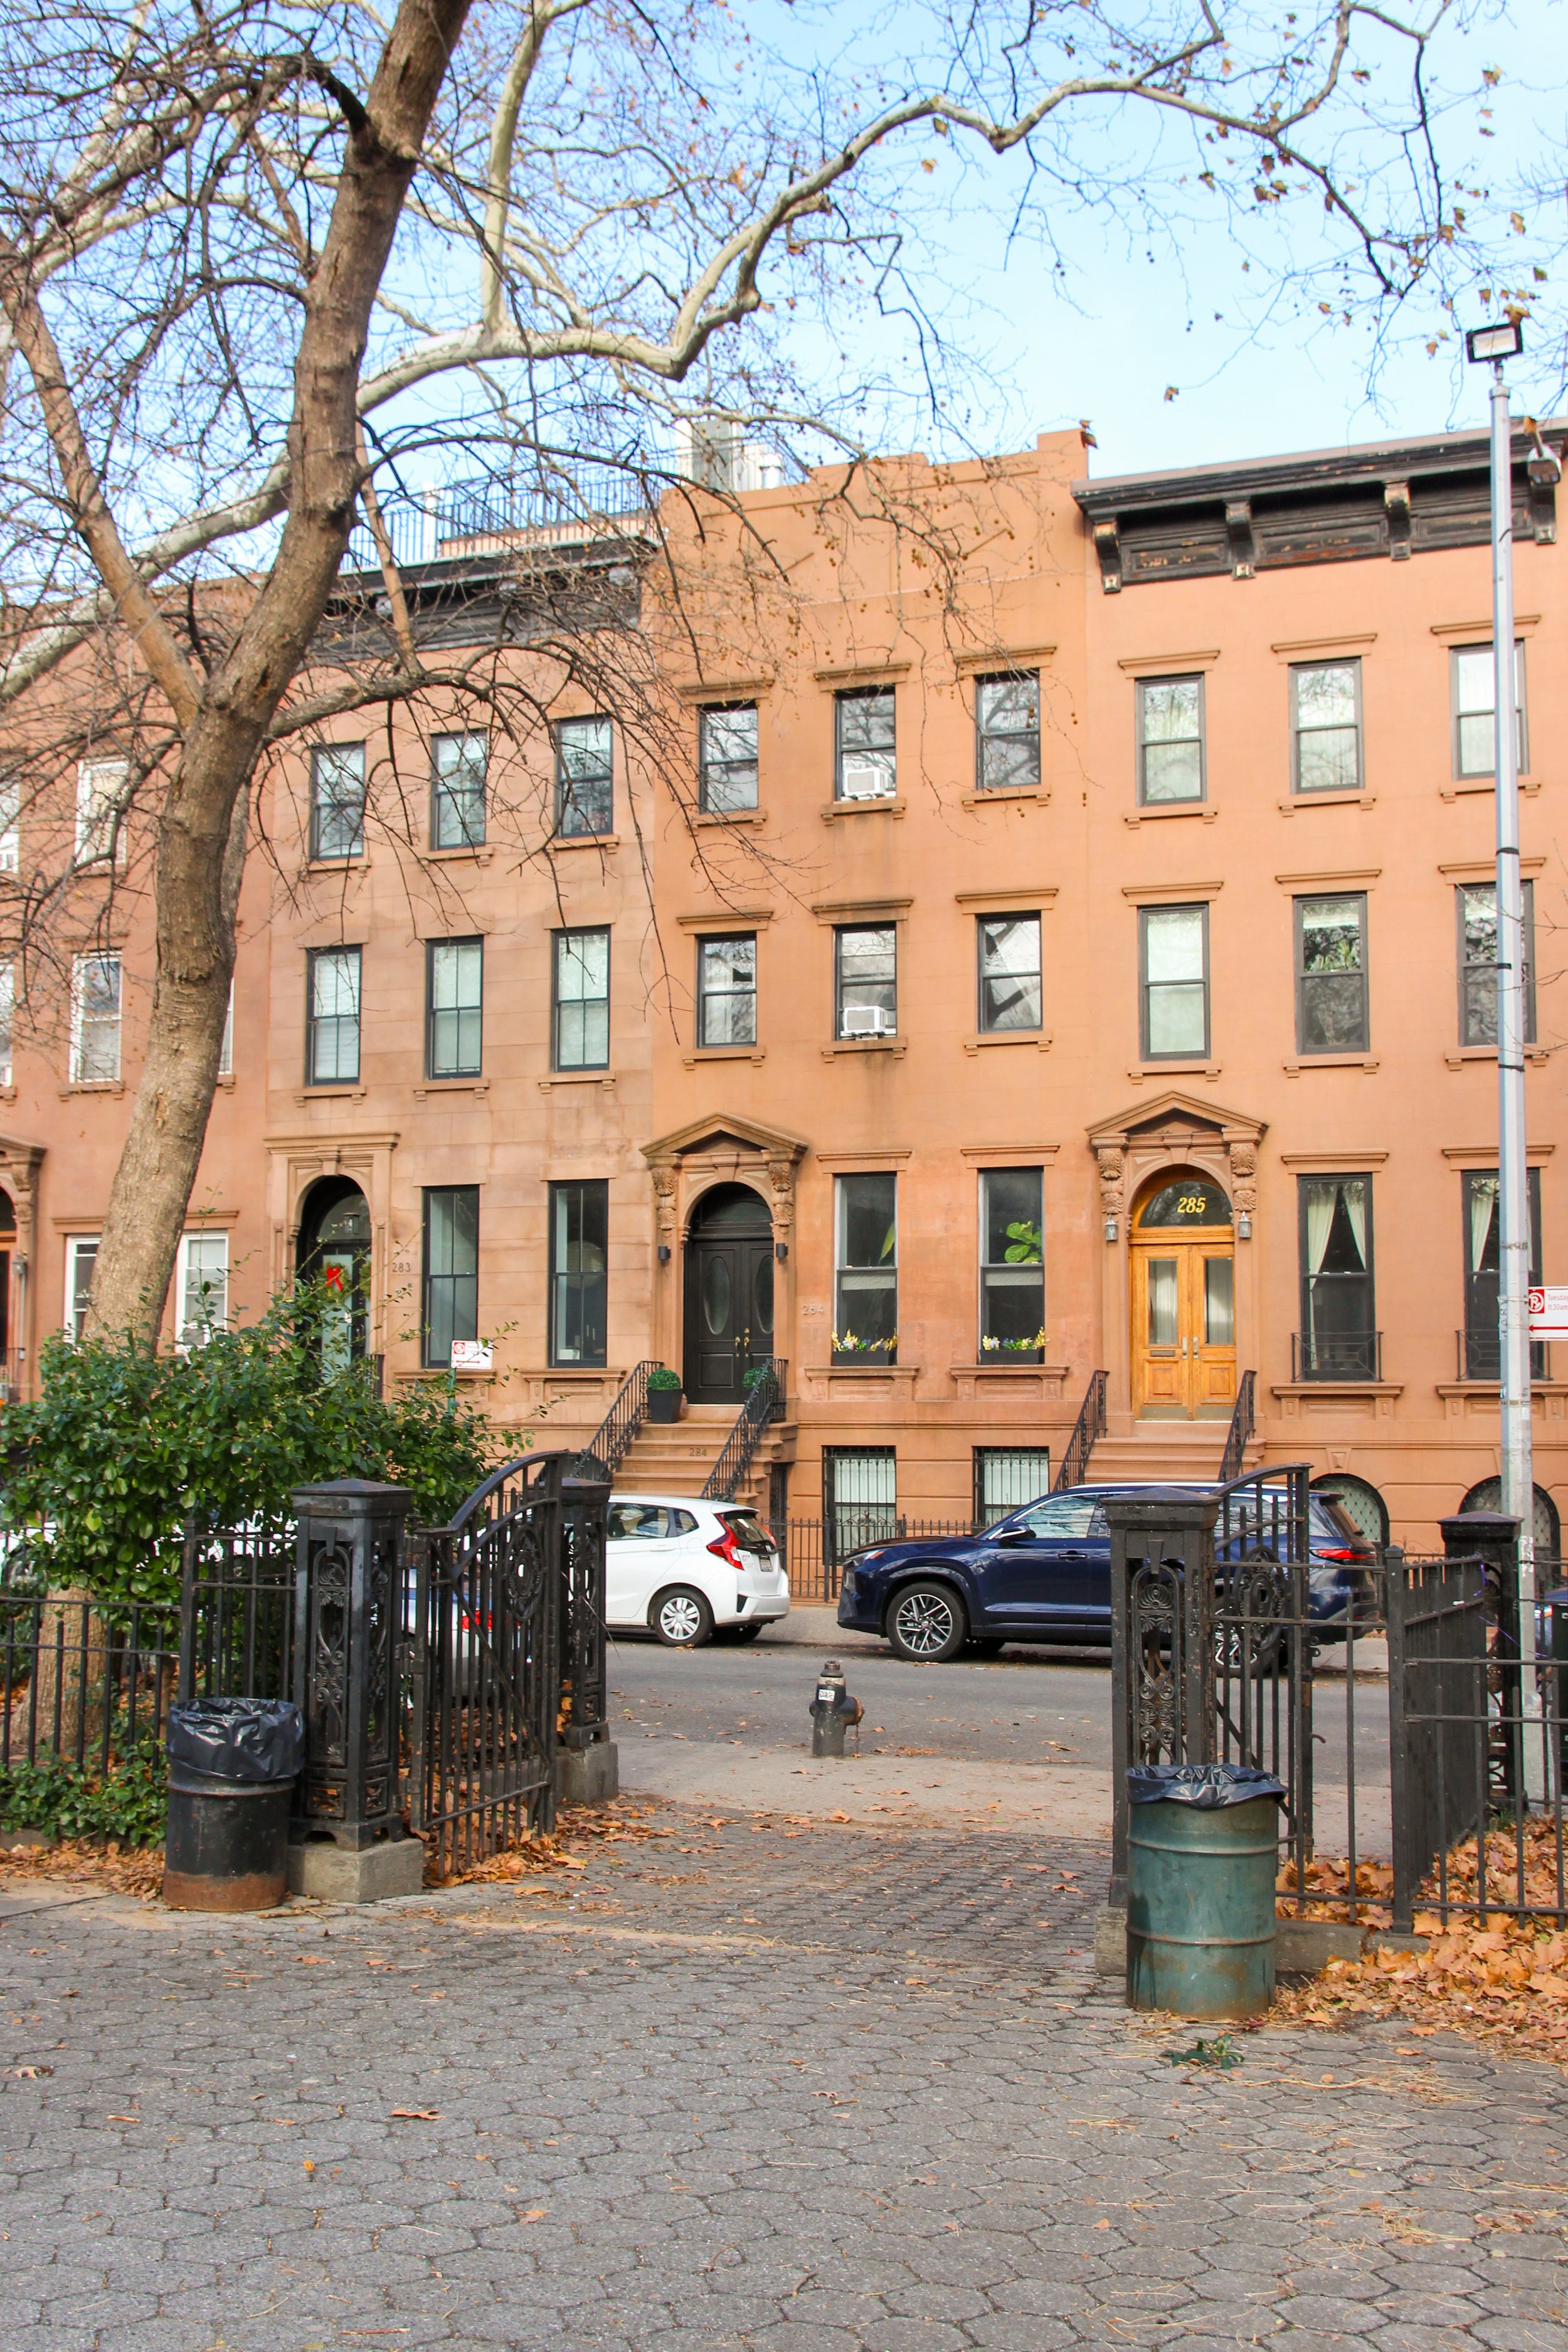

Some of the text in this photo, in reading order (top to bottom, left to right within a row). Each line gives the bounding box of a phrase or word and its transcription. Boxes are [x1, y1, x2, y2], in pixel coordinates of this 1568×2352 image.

[1177, 1196, 1207, 1214] 285
[392, 1262, 411, 1273] 283
[802, 1304, 824, 1315] 284
[689, 1447, 707, 1456] 284
